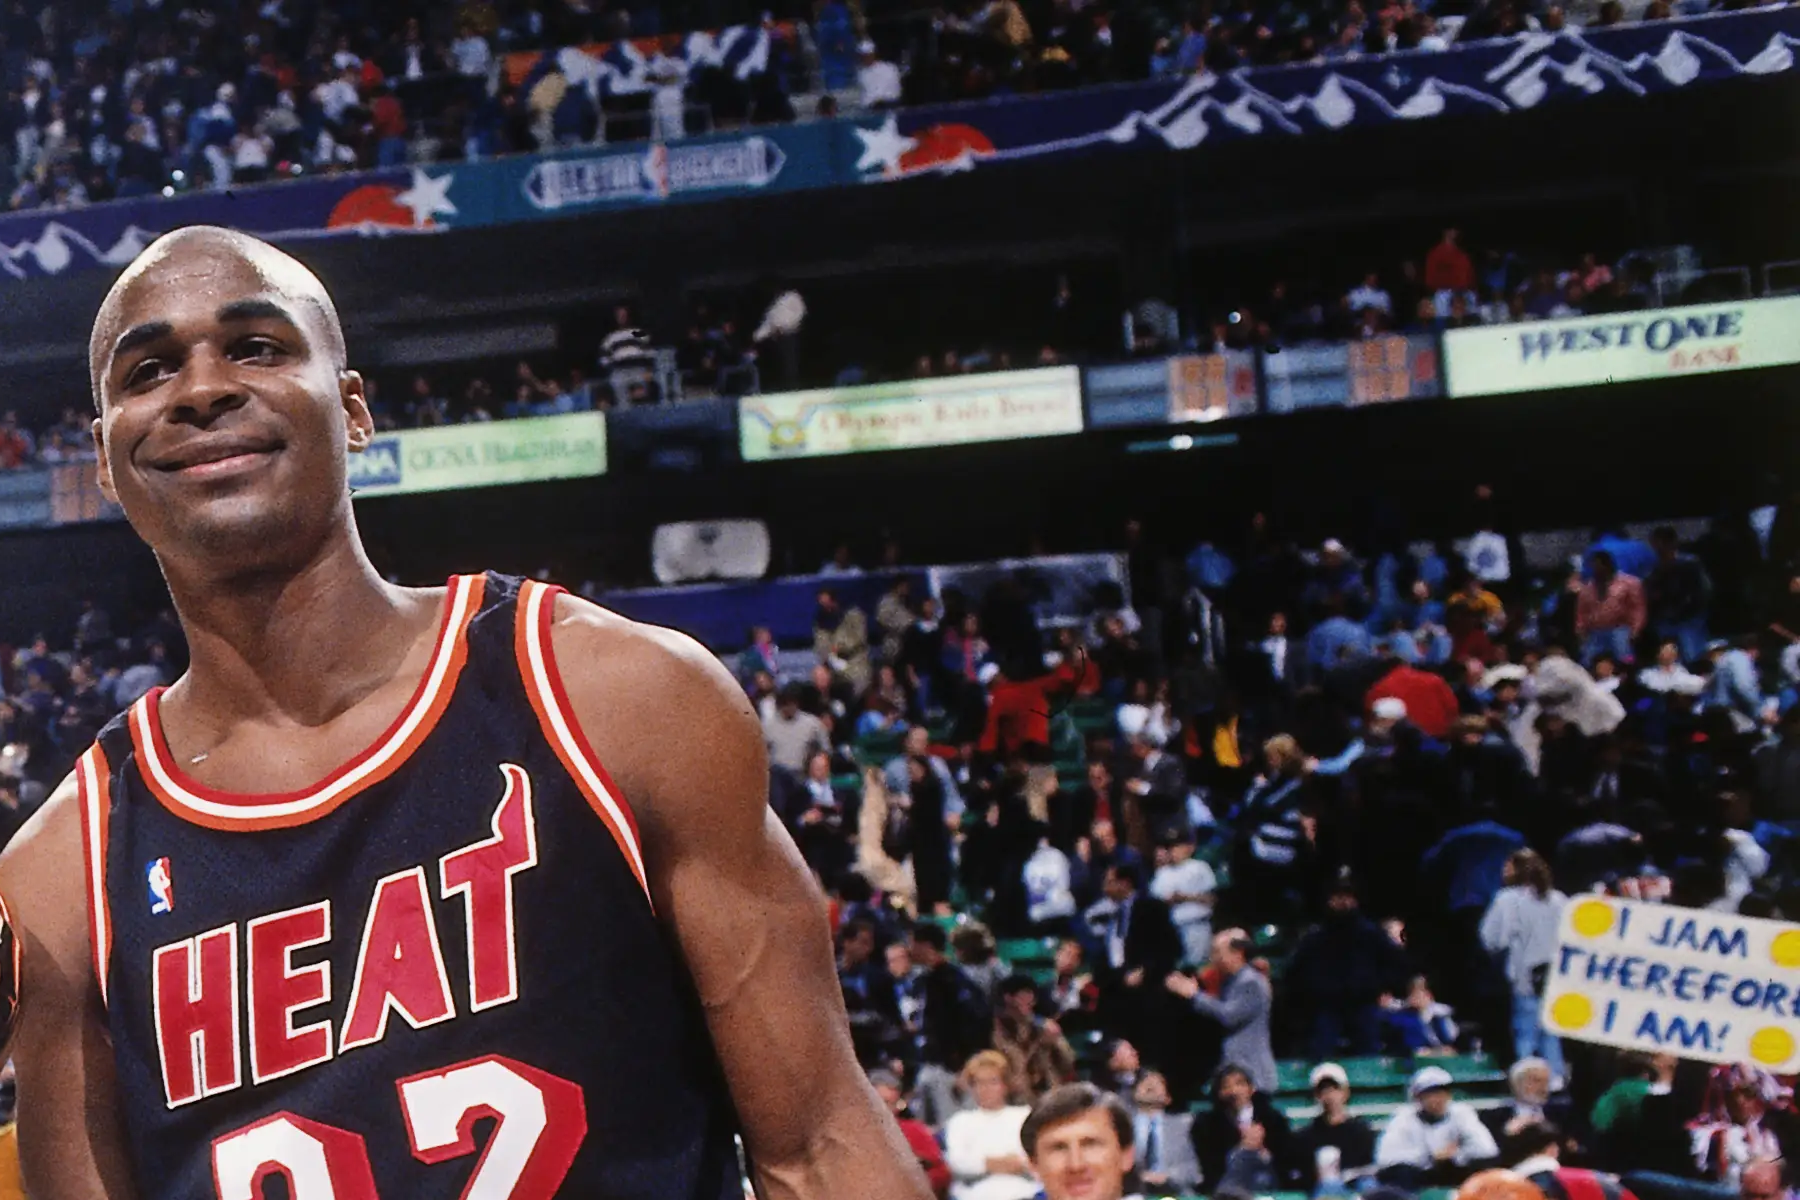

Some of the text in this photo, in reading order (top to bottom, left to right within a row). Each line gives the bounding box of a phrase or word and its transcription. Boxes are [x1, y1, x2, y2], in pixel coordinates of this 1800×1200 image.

[152, 762, 538, 1109] HEAT
[1616, 906, 1749, 958] I JAM
[1603, 1000, 1732, 1054] I AM!
